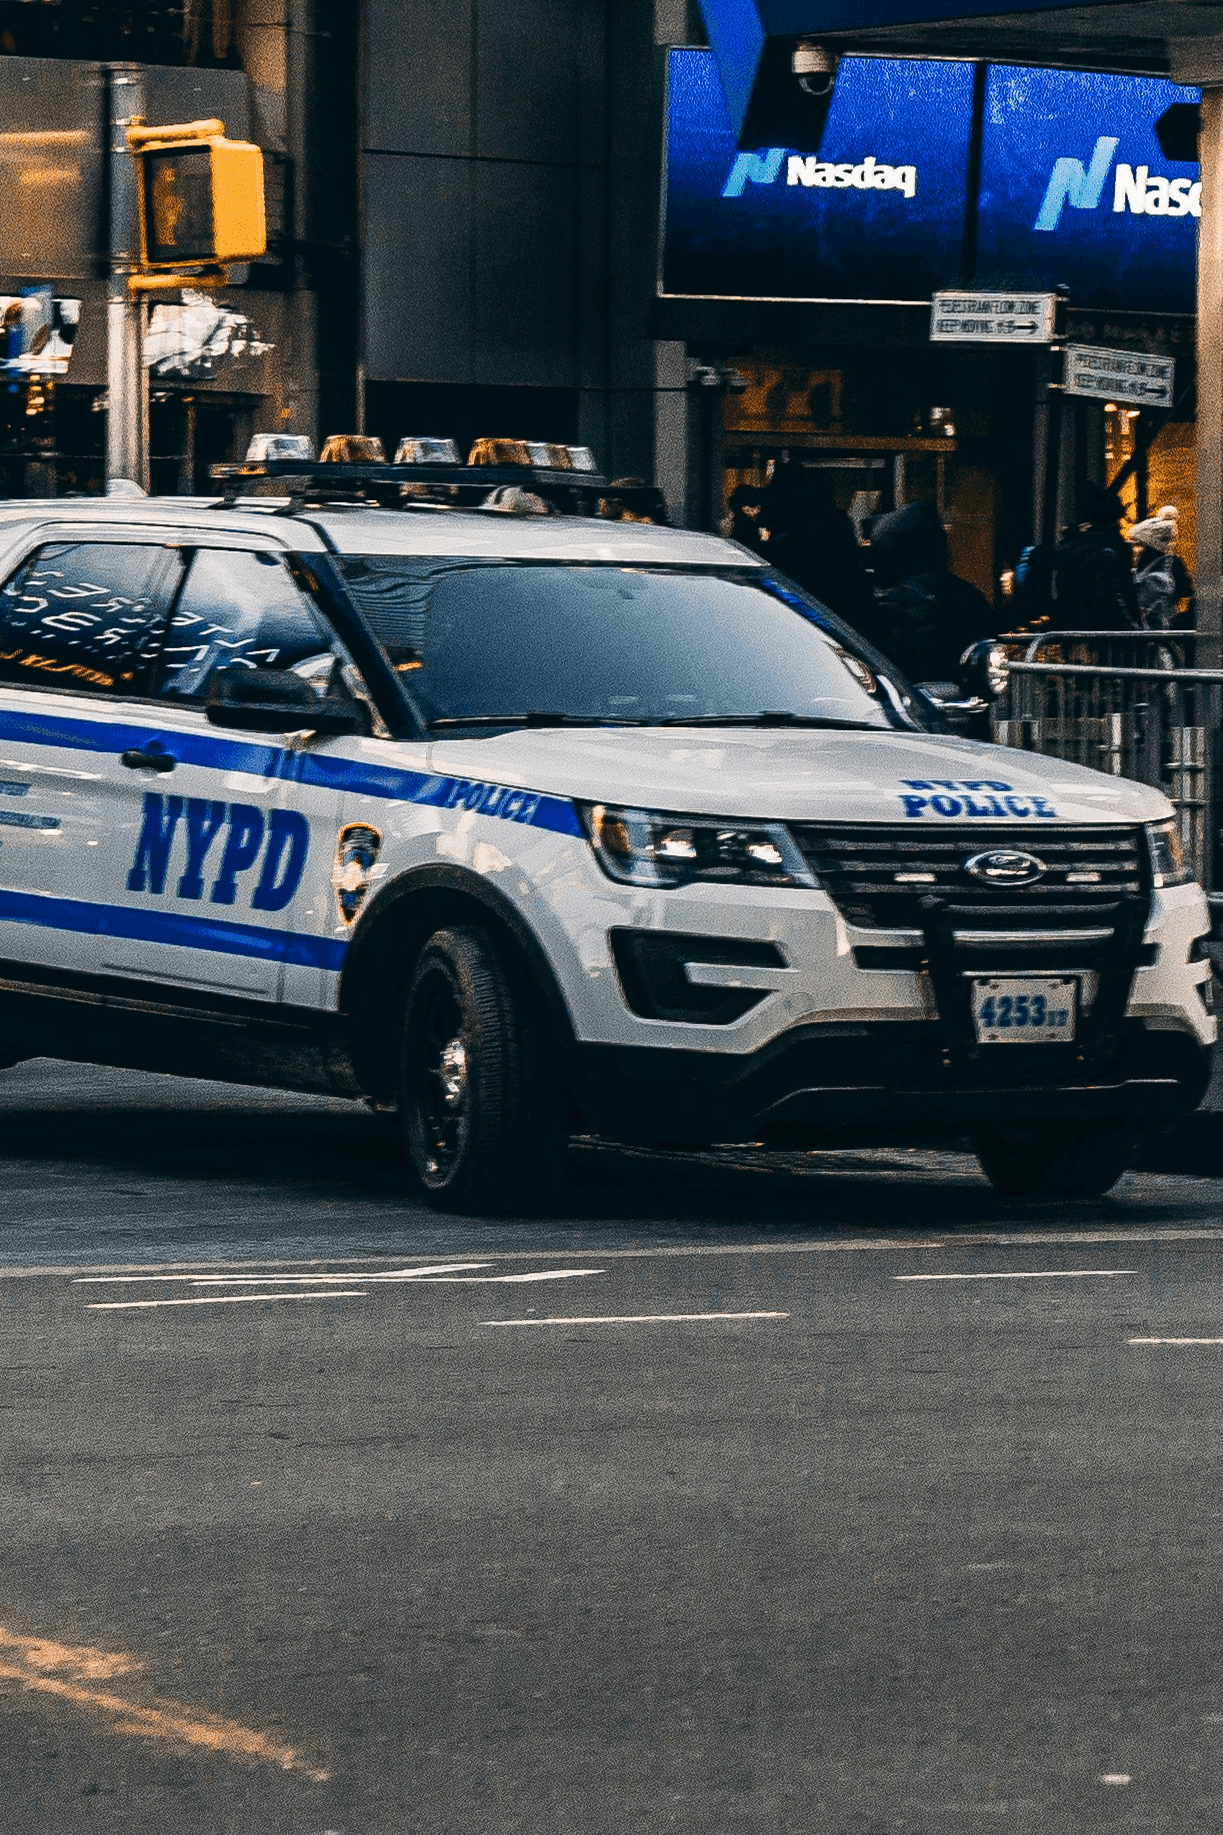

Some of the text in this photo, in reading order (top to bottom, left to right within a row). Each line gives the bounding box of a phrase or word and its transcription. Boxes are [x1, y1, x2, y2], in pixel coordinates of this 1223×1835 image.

[786, 156, 917, 198] Nasdaq
[445, 777, 541, 825] POLICE
[898, 794, 1058, 818] POLICE
[126, 791, 311, 912] NYPD
[979, 995, 1047, 1027] 4253
